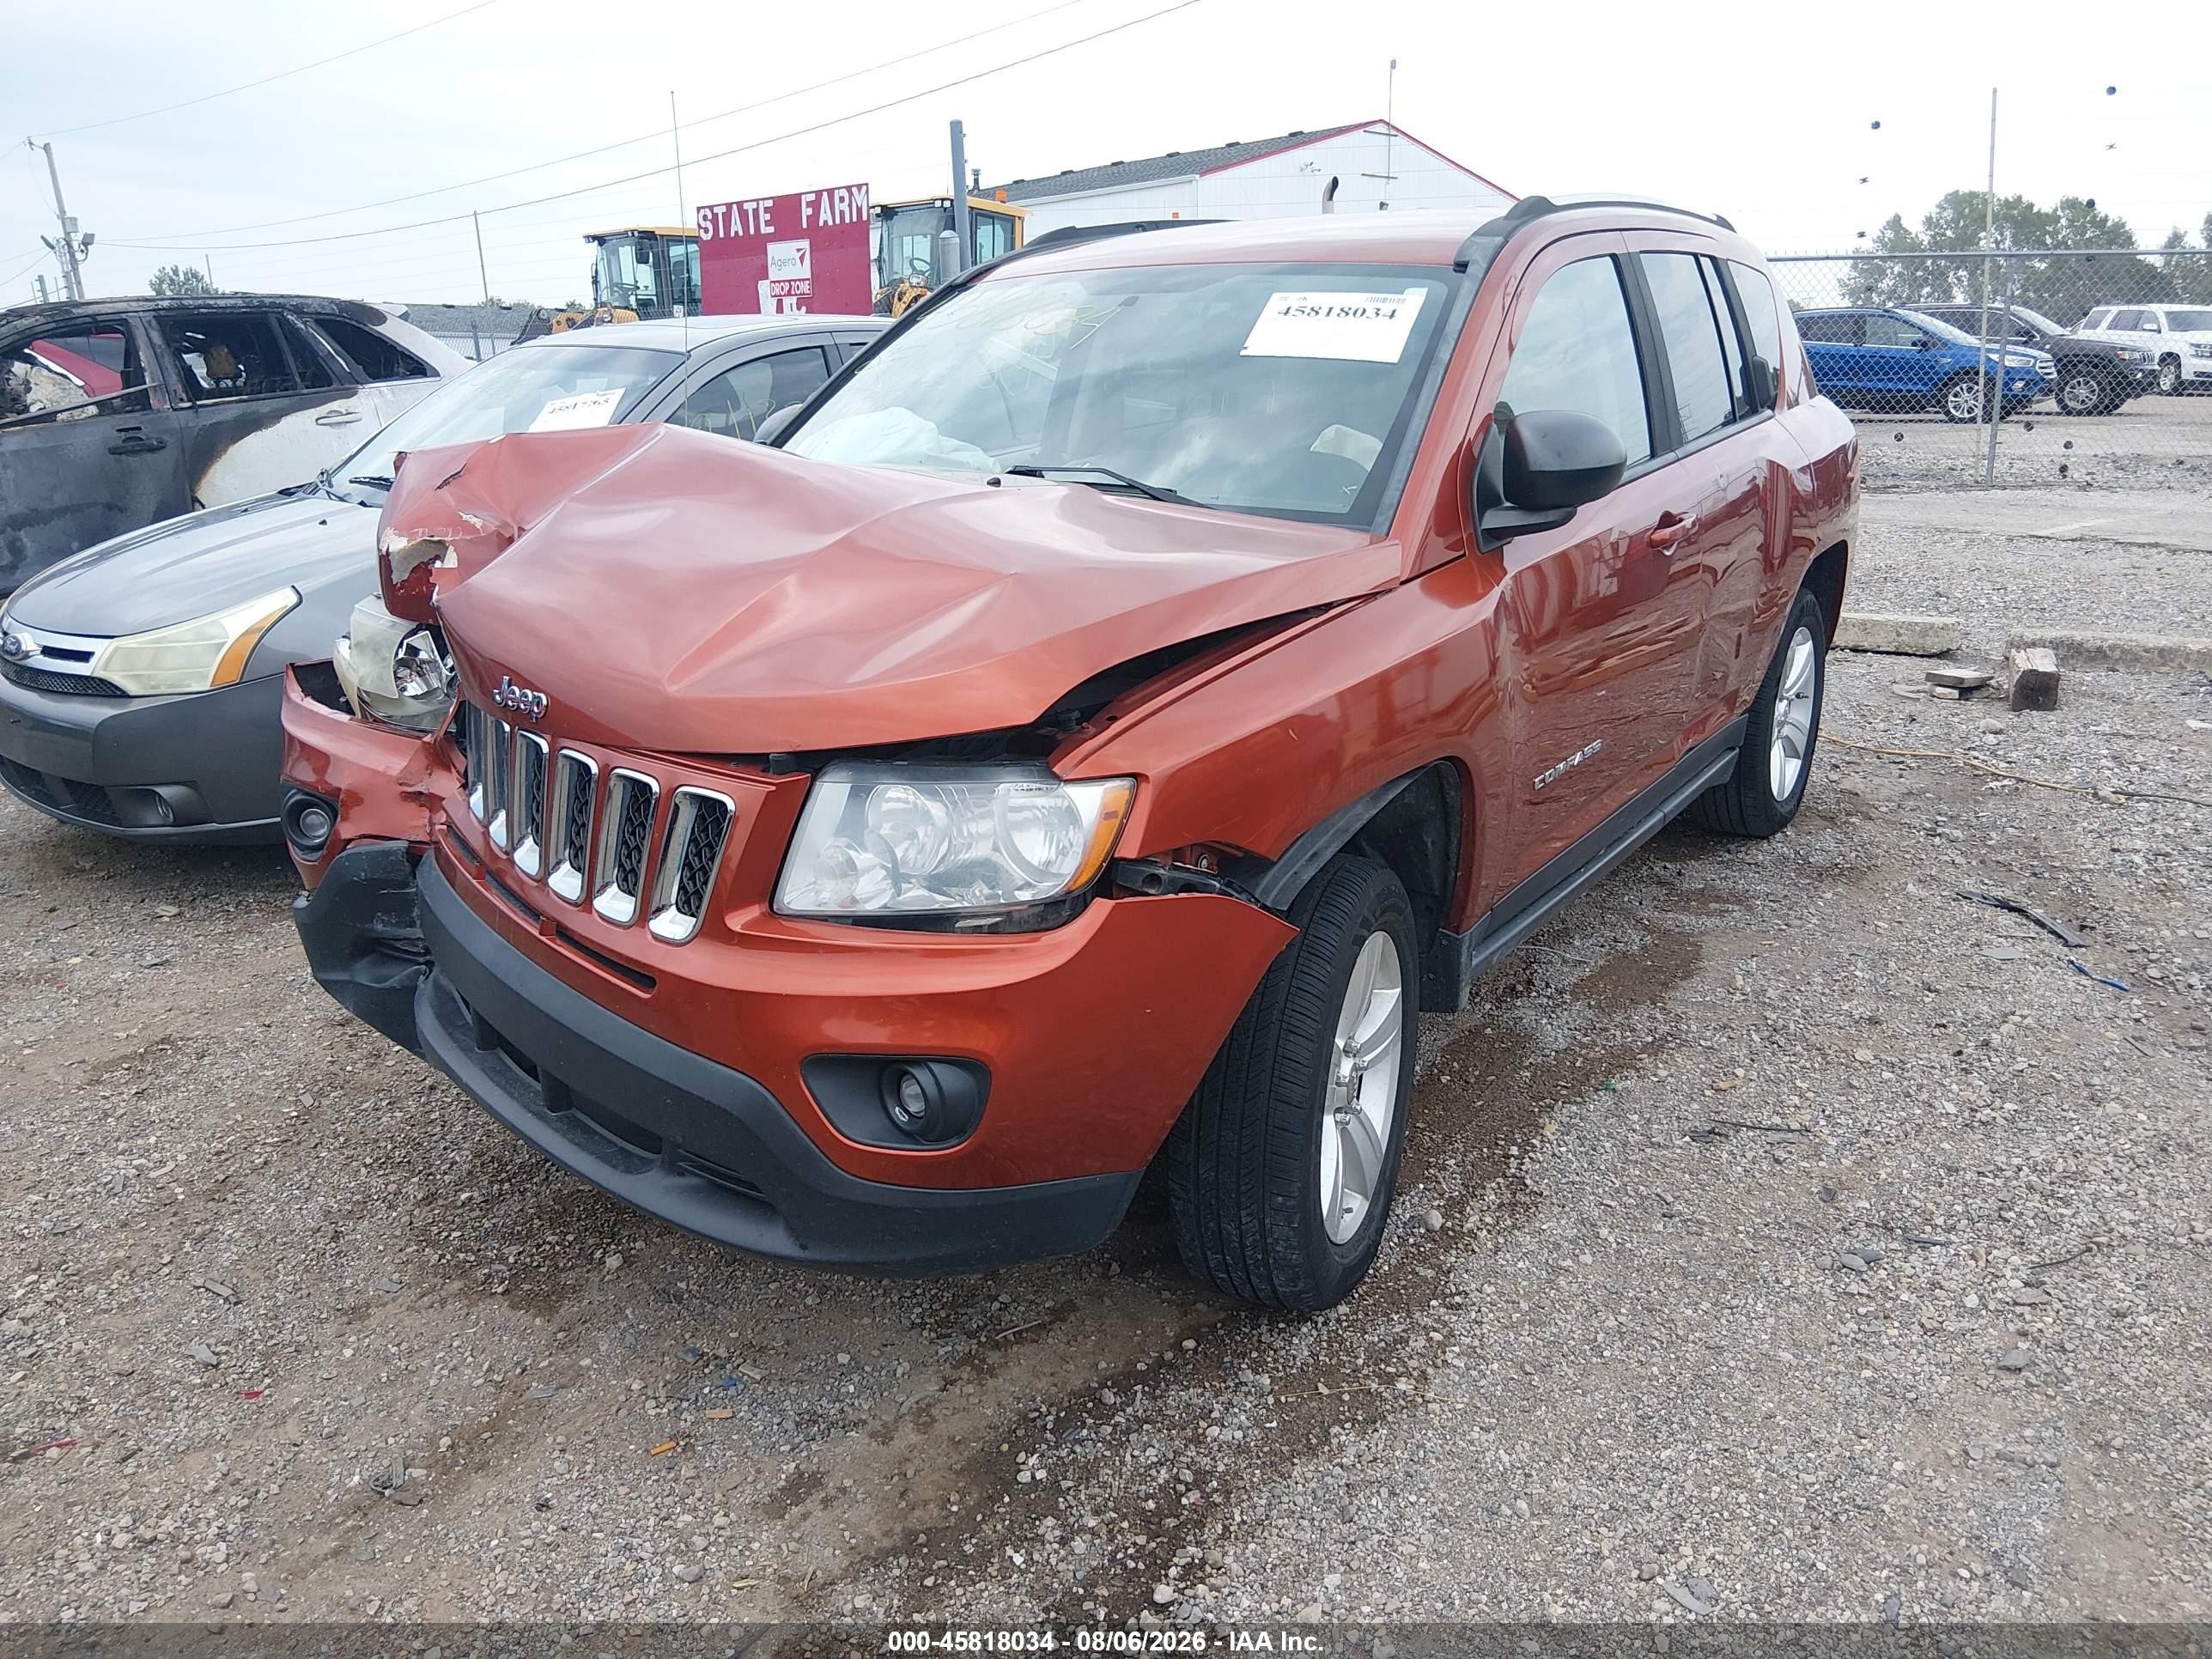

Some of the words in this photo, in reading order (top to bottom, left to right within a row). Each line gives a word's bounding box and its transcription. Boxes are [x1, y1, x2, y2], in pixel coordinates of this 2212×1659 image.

[698, 198, 775, 240] STATE
[800, 185, 868, 229] FARM
[769, 255, 797, 271] Agero
[770, 282, 790, 296] DROP
[790, 280, 811, 295] ZONE
[1277, 305, 1397, 320] 45818034
[493, 675, 549, 723] Jeep
[1534, 738, 1601, 791] COMPASS
